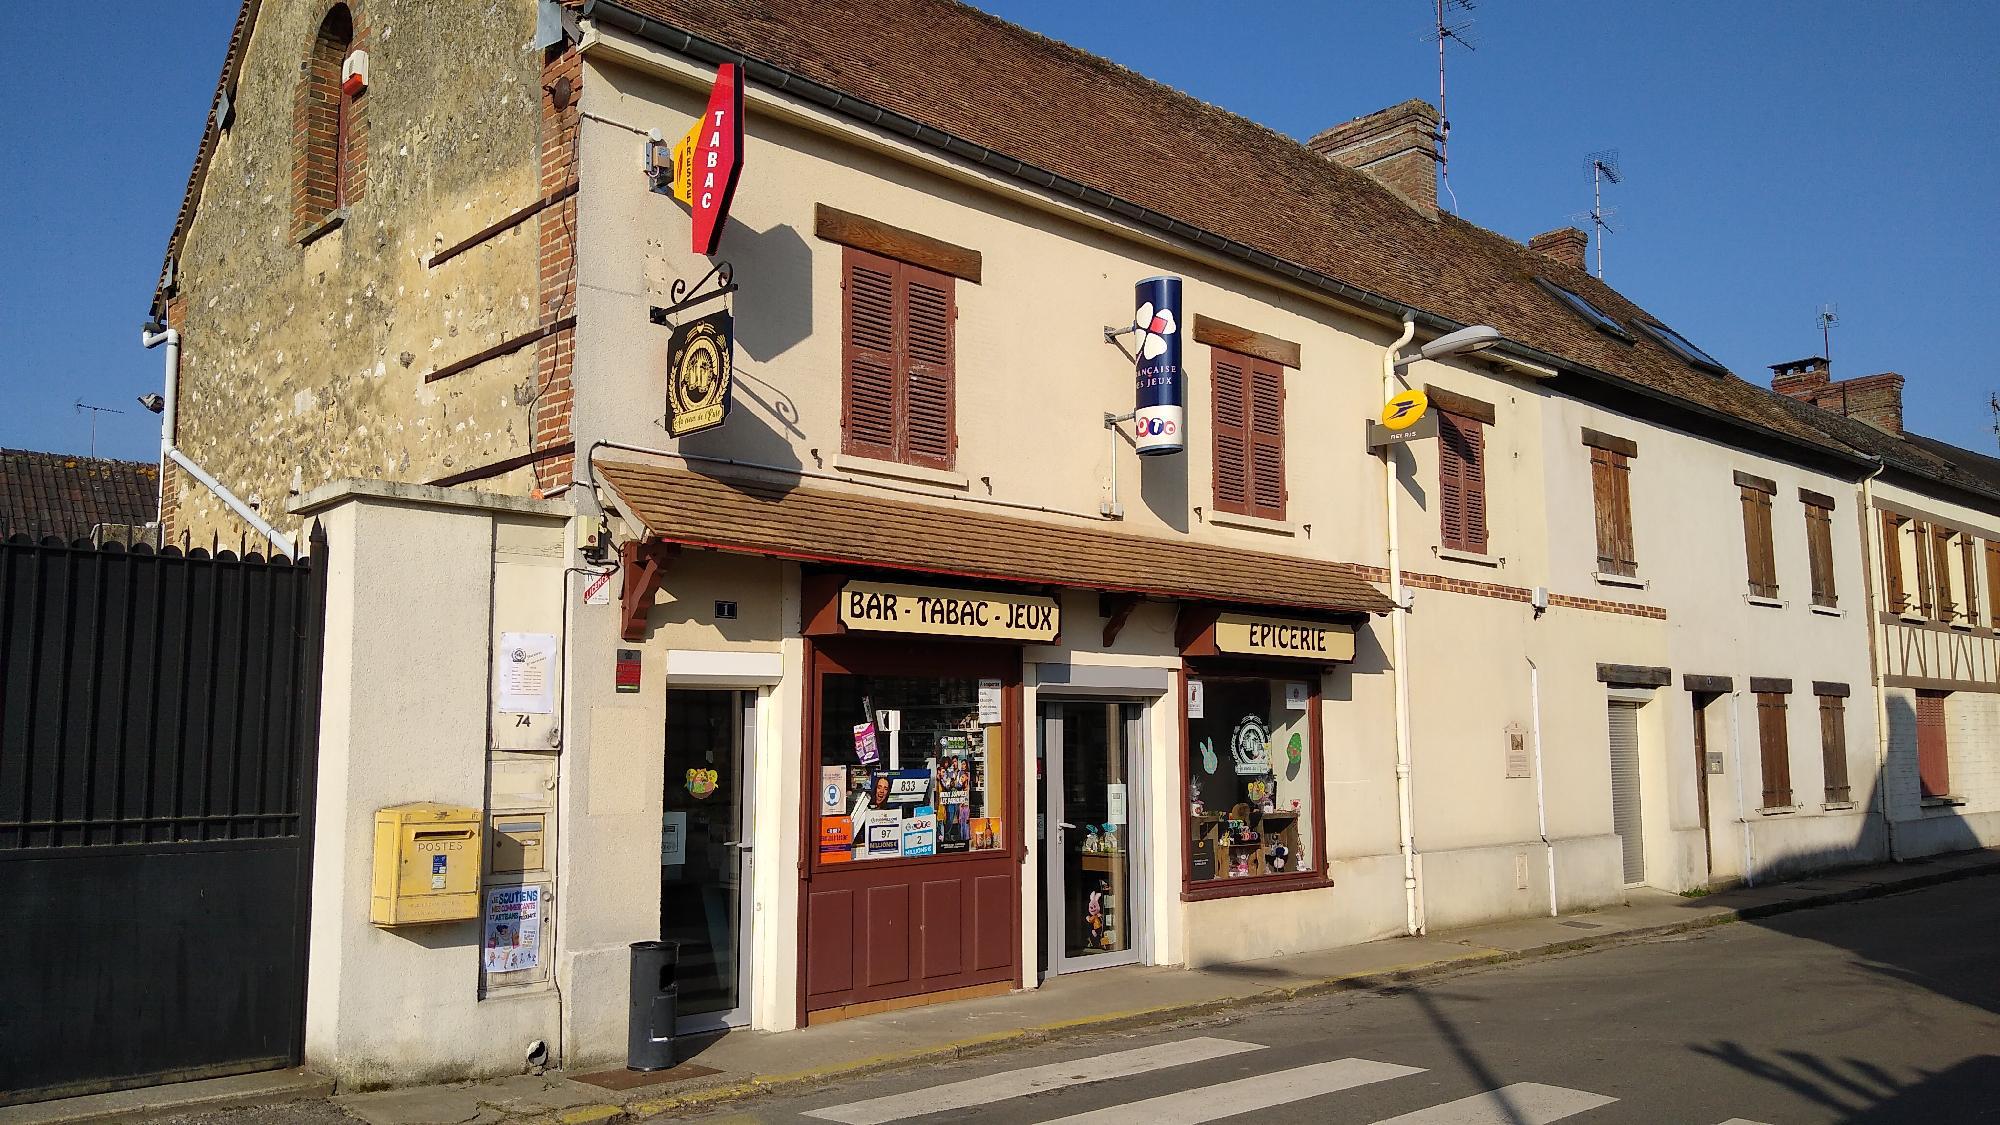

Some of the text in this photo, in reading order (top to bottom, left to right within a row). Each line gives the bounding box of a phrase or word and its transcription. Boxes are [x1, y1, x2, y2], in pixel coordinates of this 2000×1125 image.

[701, 110, 725, 209] TABAC
[1136, 366, 1177, 378] ANÇAISE
[1136, 377, 1172, 390] ES JEUX
[1136, 417, 1176, 437] OTO
[585, 574, 610, 600] LICENCE
[850, 591, 898, 621] BAR
[917, 597, 989, 626] TABAC
[1005, 603, 1052, 630] JEUX
[1250, 622, 1327, 651] EPICERIE
[515, 714, 531, 728] 74
[901, 781, 916, 791] 833
[881, 829, 892, 839] 97
[916, 836, 922, 845] 2
[417, 841, 463, 852] POSTES
[499, 889, 538, 905] SOUTIENS
